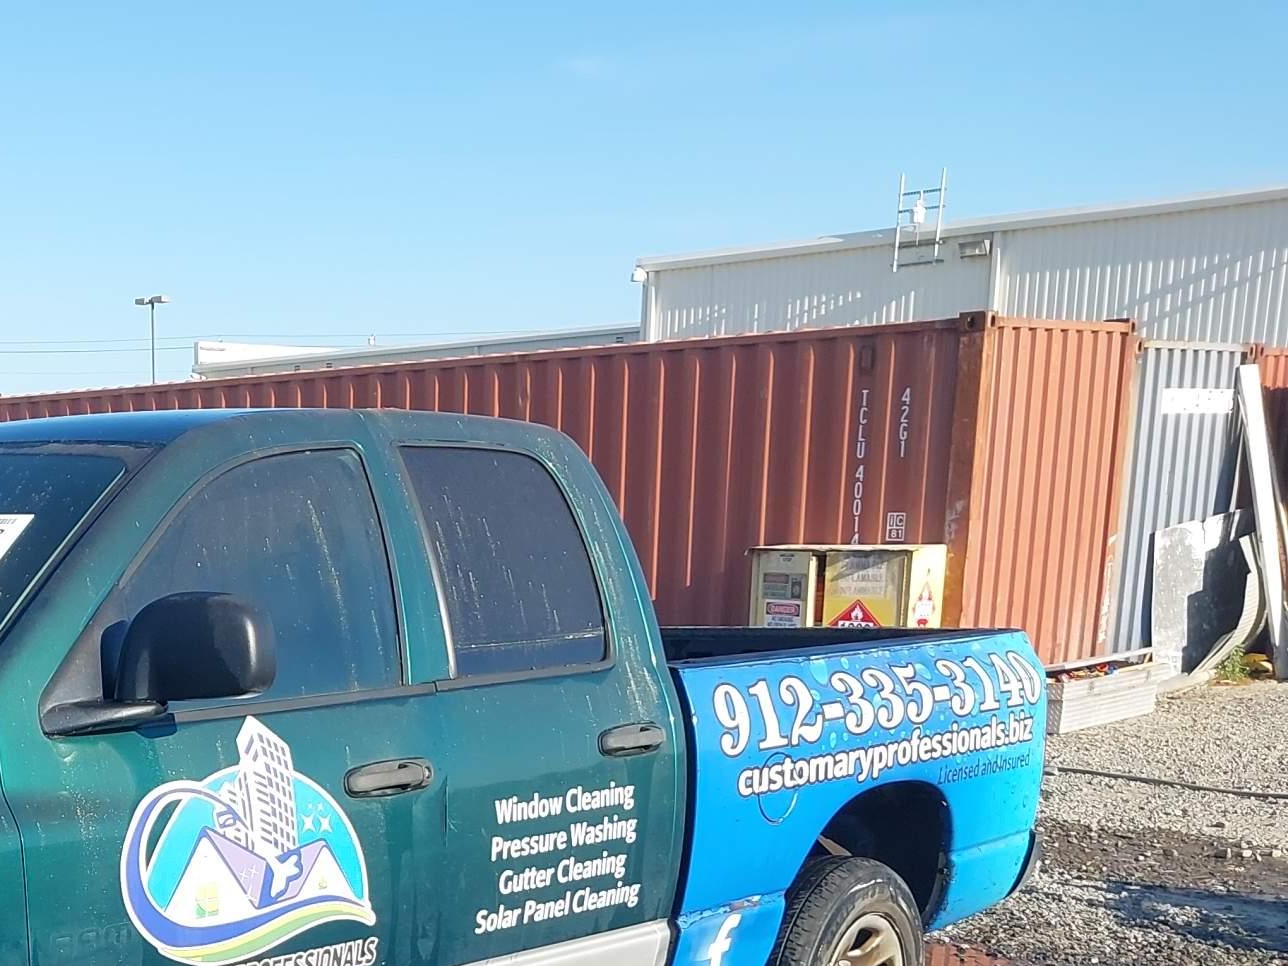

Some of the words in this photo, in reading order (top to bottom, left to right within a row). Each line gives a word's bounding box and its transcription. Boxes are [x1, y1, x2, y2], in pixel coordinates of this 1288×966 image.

[856, 389, 870, 459] TCLU
[898, 387, 911, 458] 42G1
[713, 650, 1042, 757] 912-335-3140
[737, 711, 1032, 797] customaryprofessionals.biz
[937, 758, 980, 785] Licensed
[495, 793, 563, 824] Window
[565, 781, 635, 813] Cleaning
[491, 830, 567, 862] Pressure
[570, 814, 638, 847] Washing
[499, 866, 555, 895] Gutter
[557, 851, 628, 883] Cleaning
[475, 905, 521, 935] Solar
[523, 891, 569, 924] Panel
[572, 881, 641, 914] Cleaning
